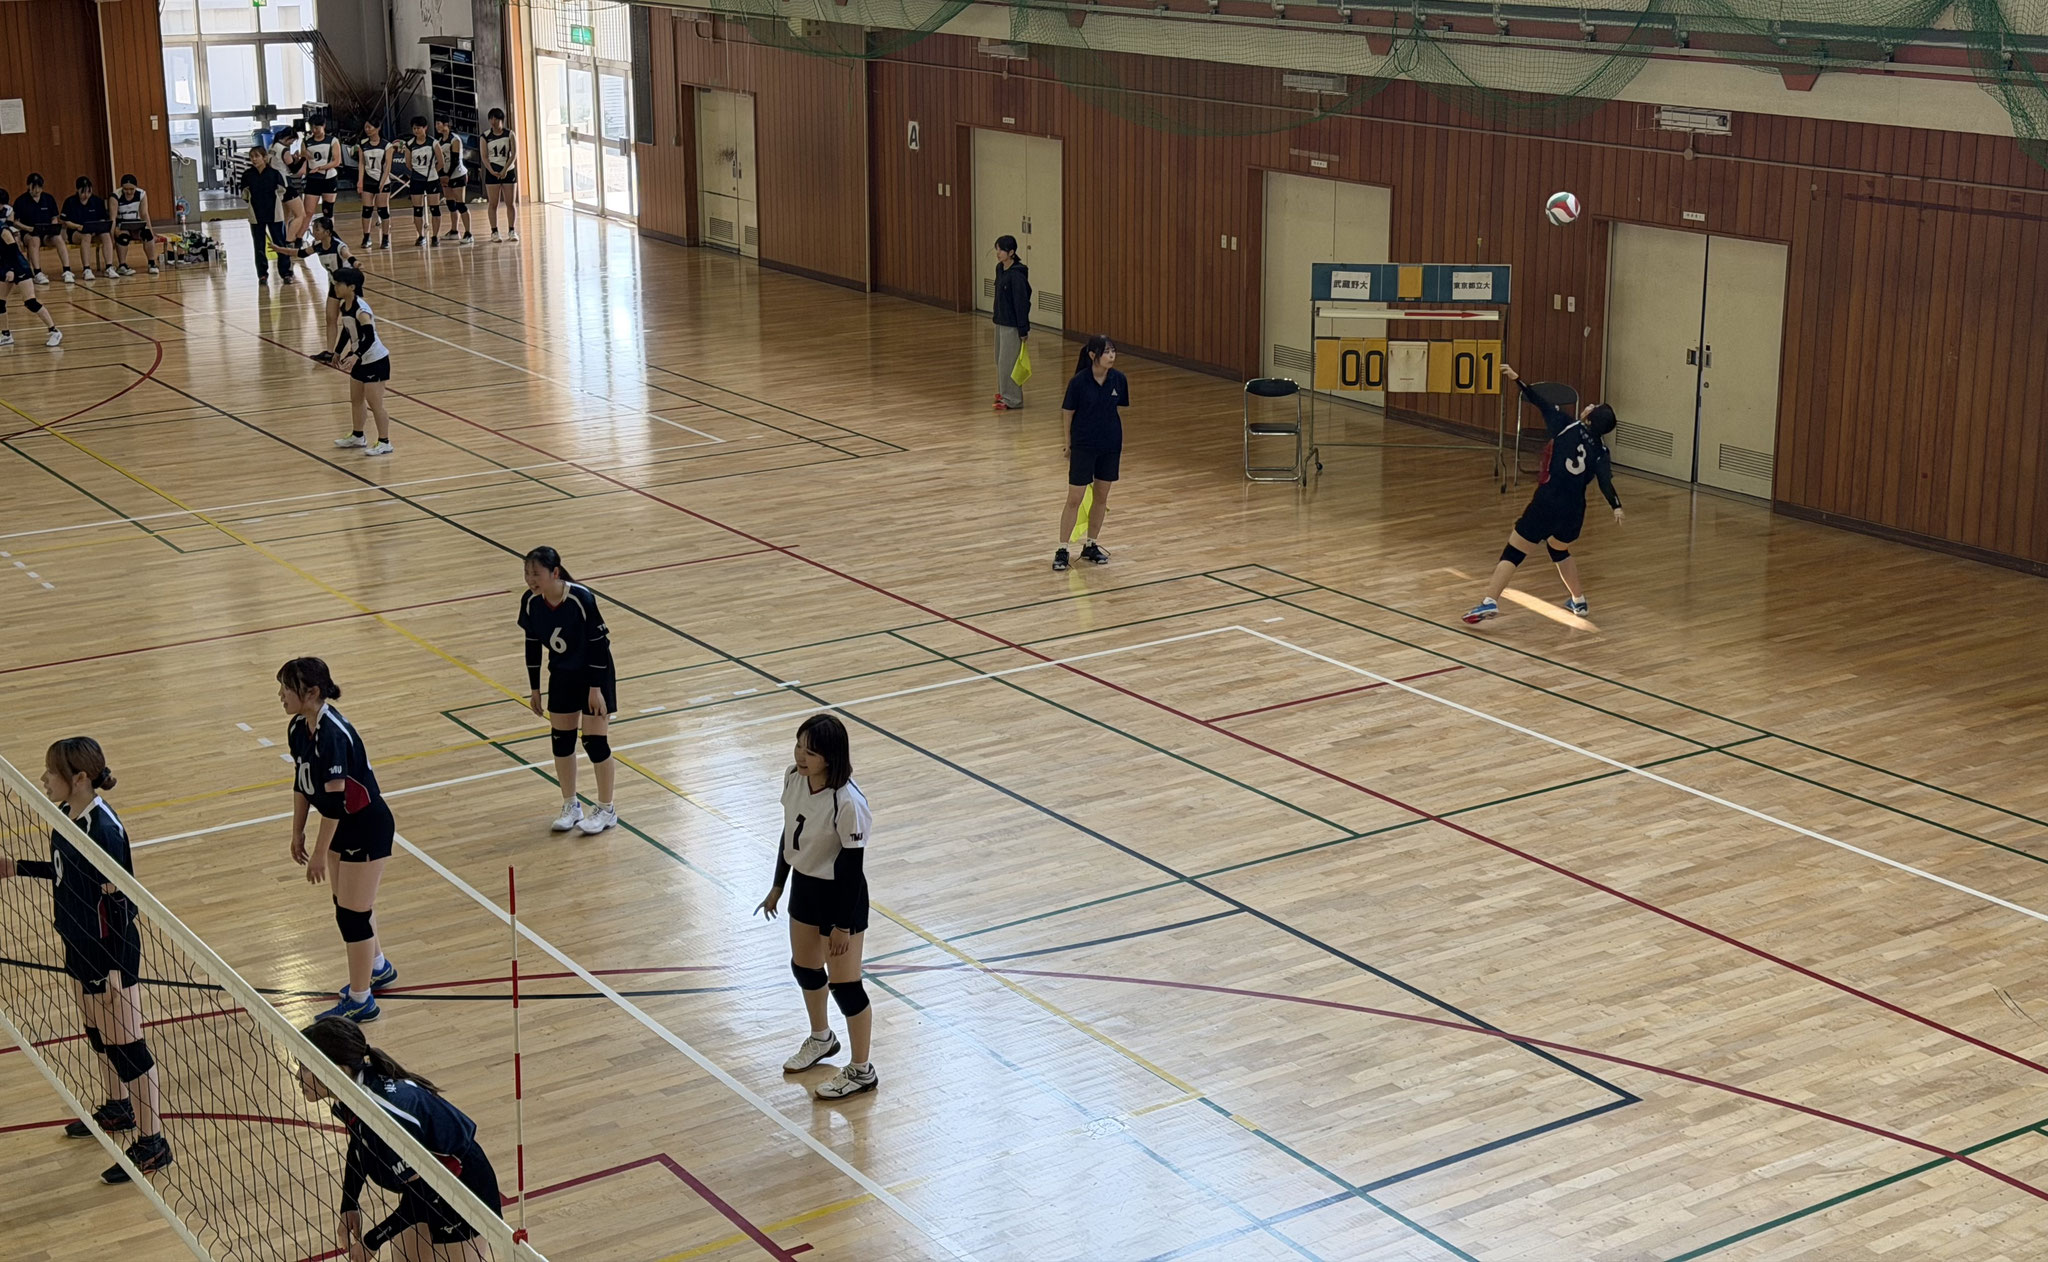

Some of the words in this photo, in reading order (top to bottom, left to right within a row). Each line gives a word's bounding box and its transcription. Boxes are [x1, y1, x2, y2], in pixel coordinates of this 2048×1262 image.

[909, 124, 918, 147] A
[313, 151, 322, 162] 9
[369, 156, 376, 169] 7
[416, 154, 428, 166] 11
[492, 145, 506, 157] 14
[1333, 280, 1368, 290] 武蔵野大
[1341, 350, 1384, 386] 00
[1455, 352, 1494, 390] 01
[1565, 443, 1587, 475] 3
[549, 627, 567, 654] 6
[793, 813, 806, 851] 1
[850, 832, 863, 842] TMU
[53, 849, 64, 887] 9
